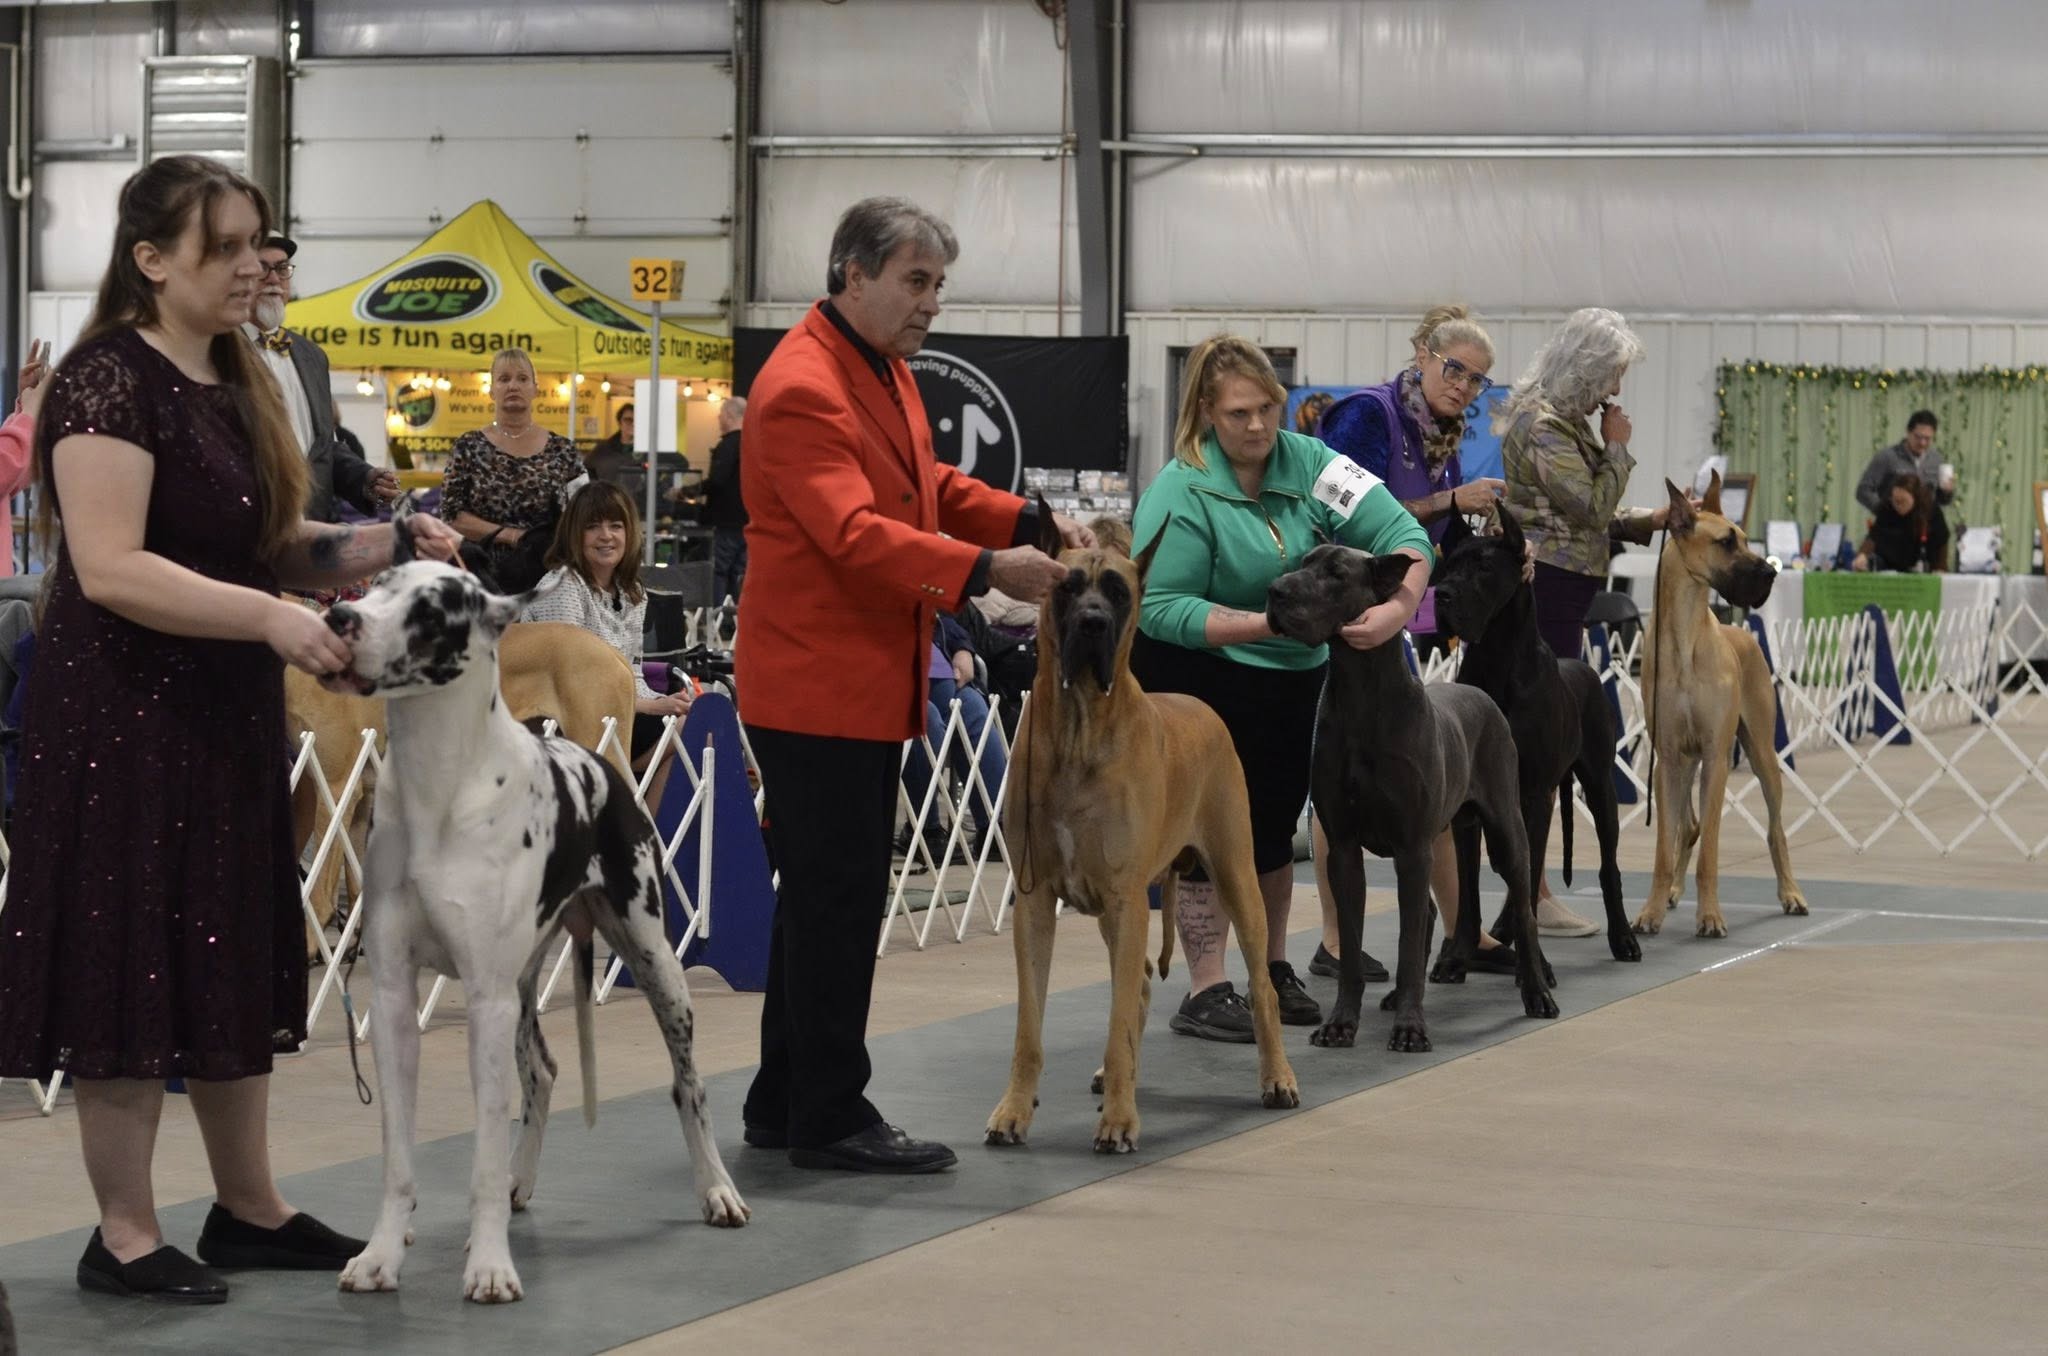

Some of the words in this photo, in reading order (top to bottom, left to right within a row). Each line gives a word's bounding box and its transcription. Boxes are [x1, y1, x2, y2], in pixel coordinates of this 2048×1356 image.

[383, 277, 482, 294] MOSQUITO
[633, 266, 668, 293] 32
[374, 292, 470, 313] JOE
[359, 326, 381, 347] is
[393, 325, 439, 348] fun
[451, 329, 542, 354] again.
[594, 330, 651, 356] Outside
[670, 335, 691, 358] fun
[905, 359, 949, 376] saving
[949, 368, 995, 408] puppies
[449, 403, 484, 413] We've
[536, 403, 590, 414] Coverd!
